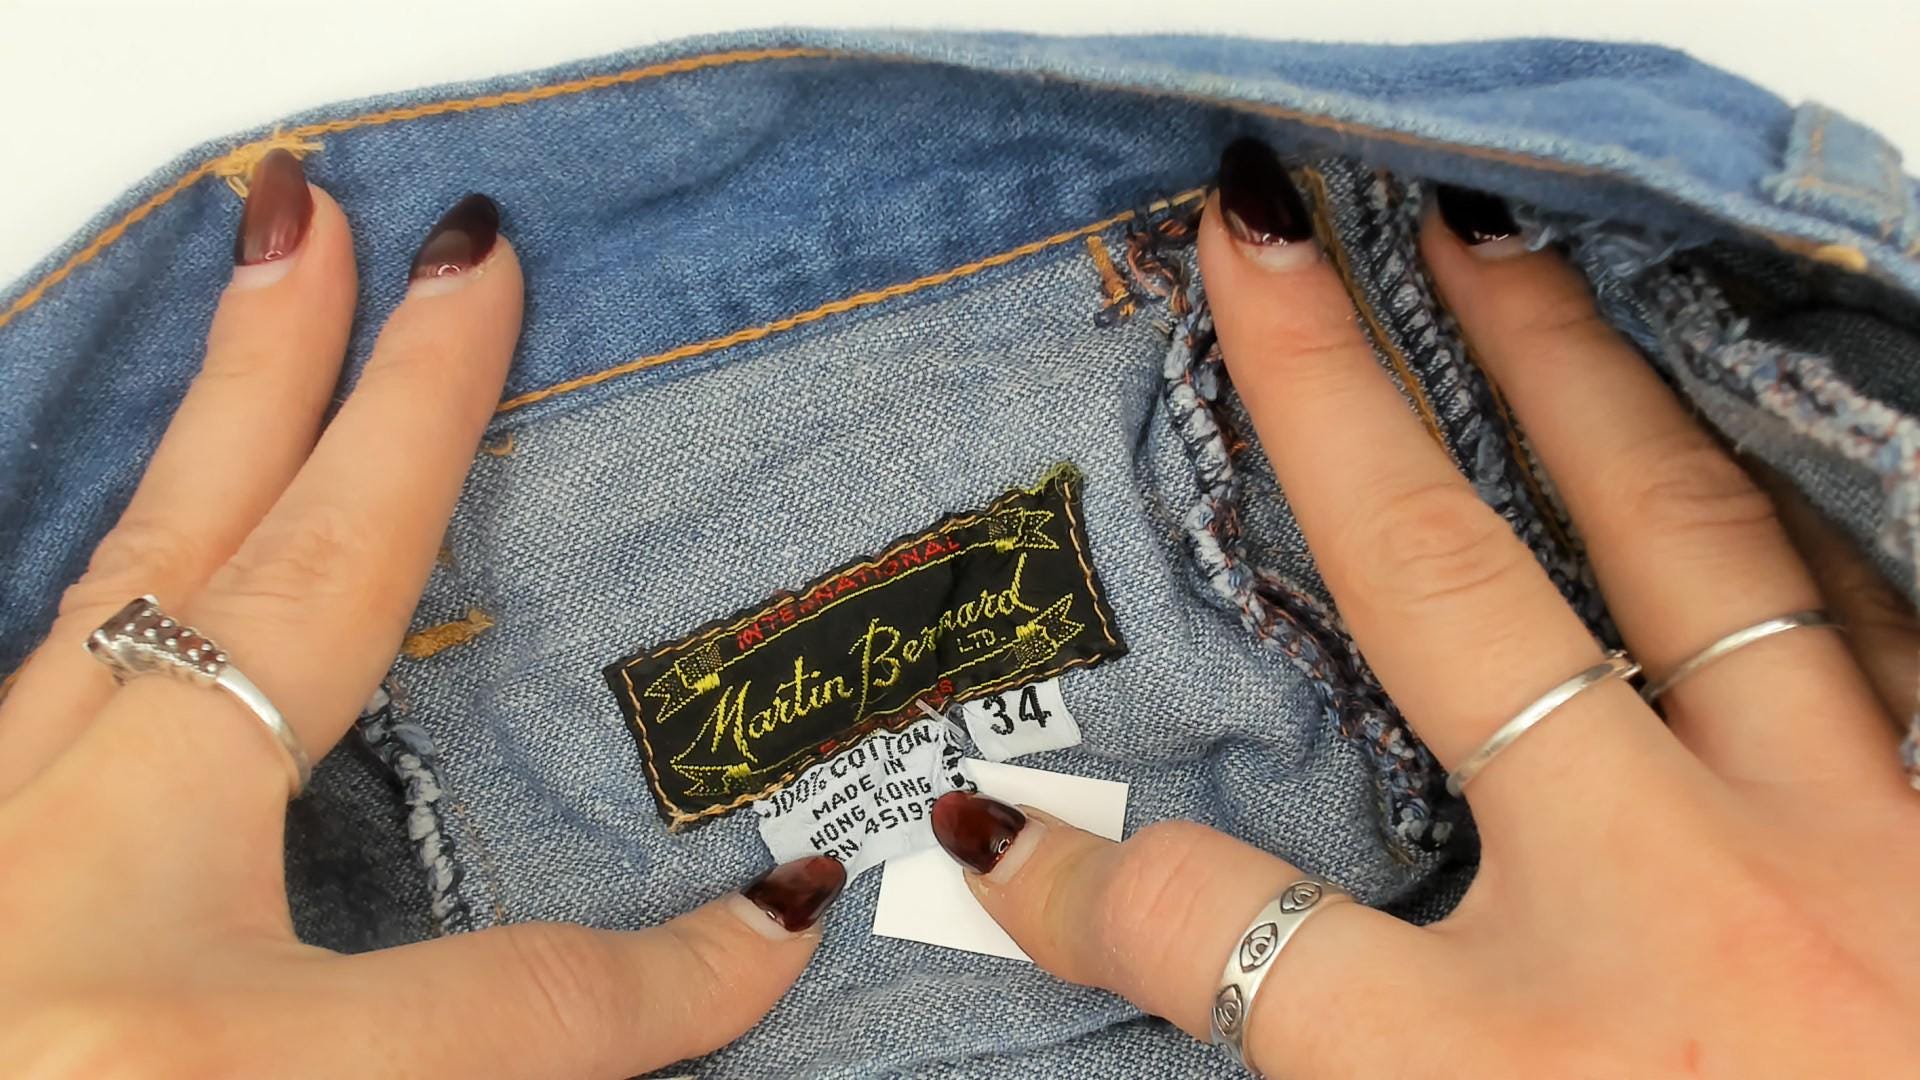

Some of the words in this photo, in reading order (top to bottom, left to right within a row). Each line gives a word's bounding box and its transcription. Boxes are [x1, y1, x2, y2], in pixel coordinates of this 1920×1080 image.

[670, 656, 854, 763] Martin
[848, 552, 1039, 722] Bernard
[983, 685, 1052, 735] 34
[764, 767, 827, 818] 100%
[830, 725, 932, 778] COTTON
[812, 774, 875, 820] MADE
[883, 758, 906, 776] IN
[810, 805, 866, 850] HONG
[873, 777, 931, 807] KONG
